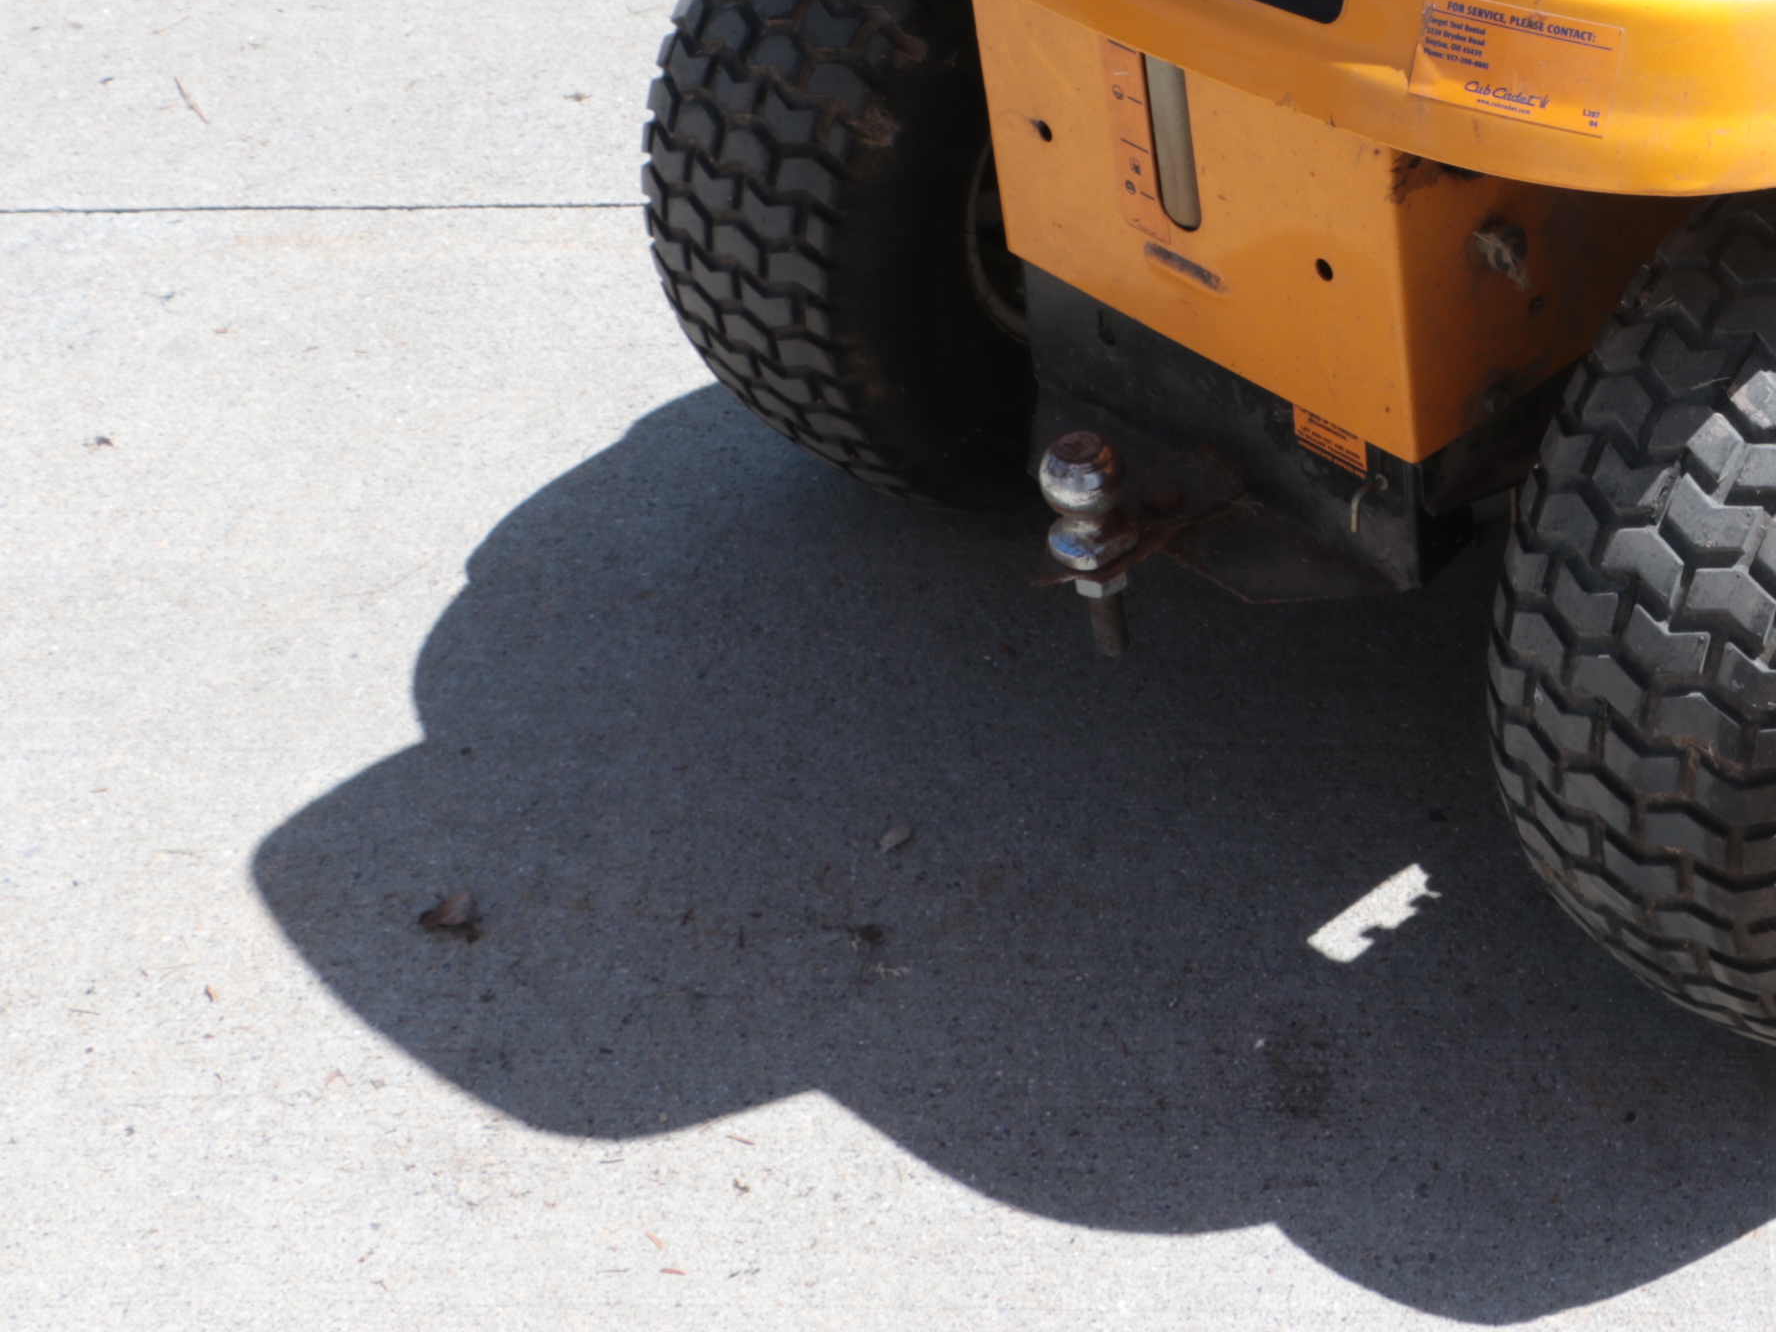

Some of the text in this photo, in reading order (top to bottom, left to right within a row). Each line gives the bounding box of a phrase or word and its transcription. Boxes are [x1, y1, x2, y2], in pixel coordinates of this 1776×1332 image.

[1447, 1, 1597, 43] FOR SERVICE, PLEASE CONTACT:
[1464, 24, 1486, 35] Rental
[1468, 36, 1486, 46] Road
[1464, 80, 1541, 107] Cub Cadet
